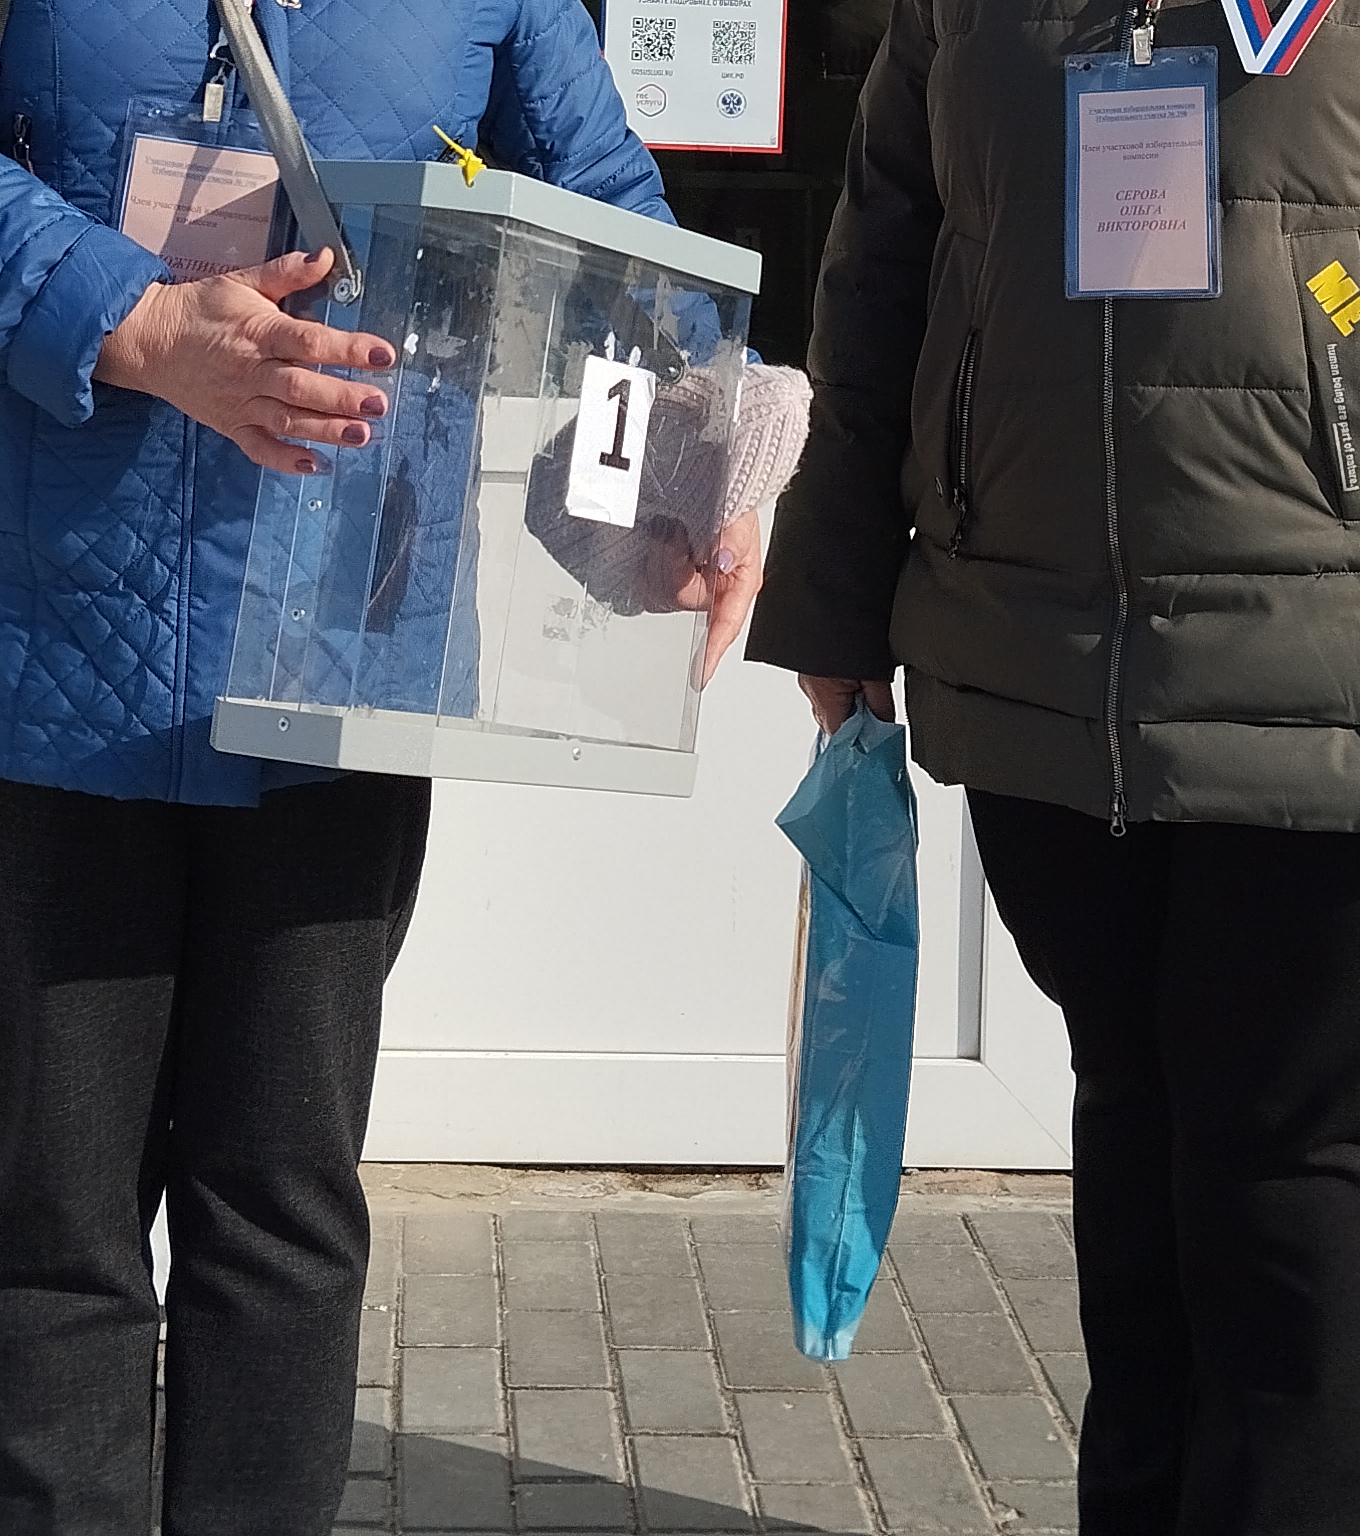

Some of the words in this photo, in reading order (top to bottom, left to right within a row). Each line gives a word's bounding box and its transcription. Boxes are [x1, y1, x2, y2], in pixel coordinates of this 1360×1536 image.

[1115, 188, 1167, 202] СЕРОВА
[1120, 204, 1162, 217] ОЛЬГА
[1096, 219, 1187, 233] ВИКТОРОВНА
[1337, 404, 1348, 421] are
[597, 378, 633, 472] 1
[1337, 421, 1353, 443] part
[1343, 442, 1356, 453] of
